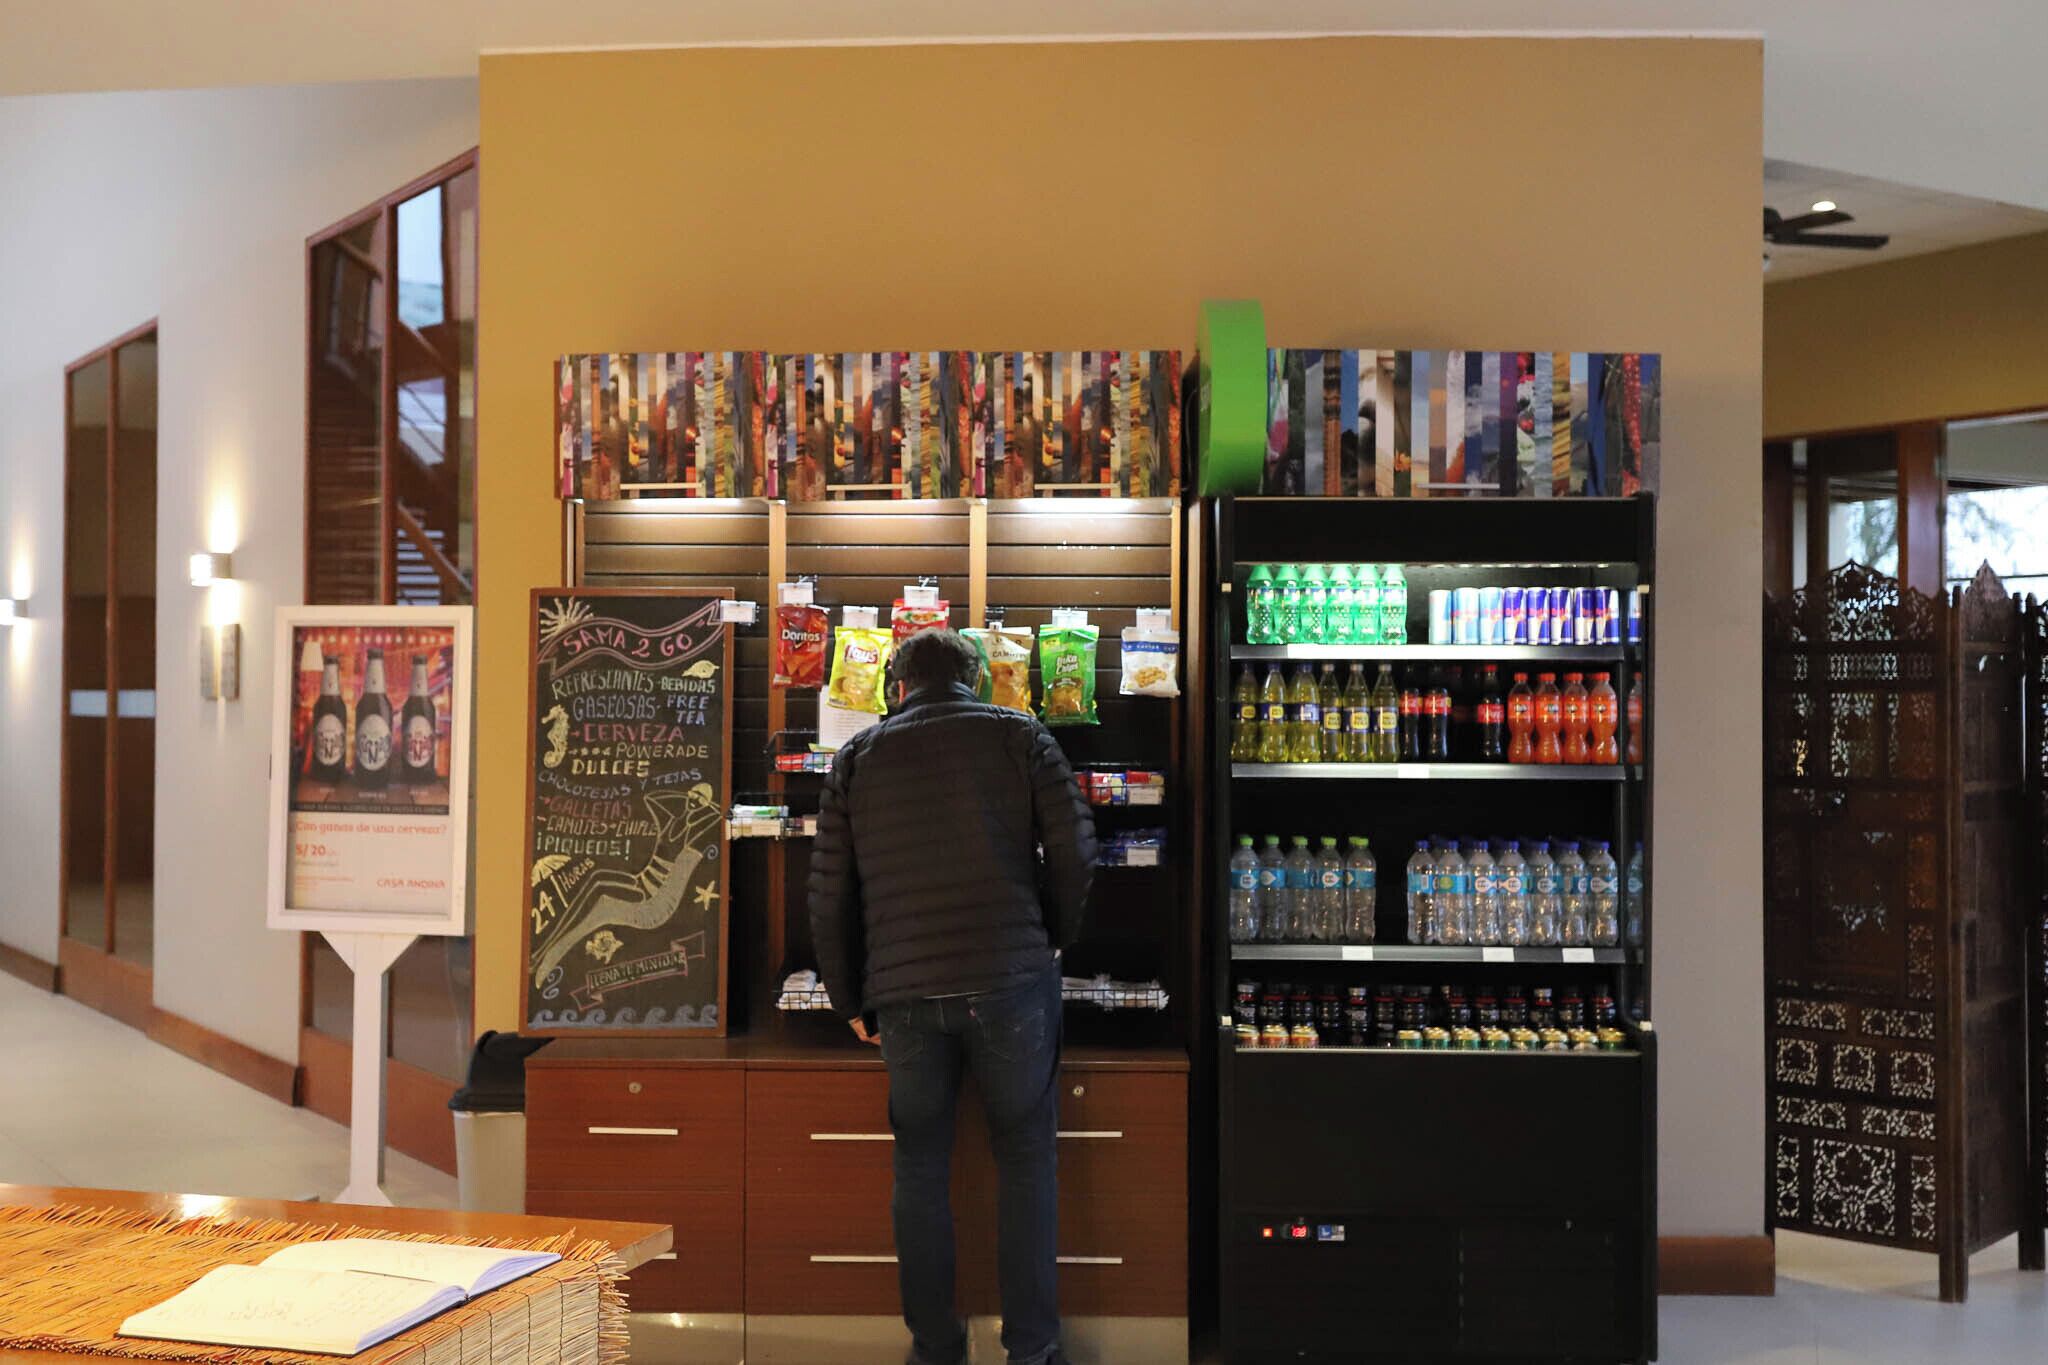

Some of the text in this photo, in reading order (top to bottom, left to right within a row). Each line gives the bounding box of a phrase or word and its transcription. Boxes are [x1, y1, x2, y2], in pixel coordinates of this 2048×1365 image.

[563, 627, 692, 657] SAMA 2 GO
[782, 629, 820, 642] Doritos
[552, 669, 654, 699] REFRESCANTES
[660, 676, 716, 694] BEBIDAS
[573, 695, 656, 721] GASEOSAS
[667, 695, 709, 710] FREE
[676, 710, 706, 726] TEA
[584, 723, 685, 743] CERVEZA
[616, 742, 709, 758] POWERADE
[571, 759, 651, 777] DULCES
[538, 768, 702, 799] CHOCOTEJAS Y TEJAS
[550, 798, 633, 819] GALLETAS
[356, 821, 370, 832] de
[373, 823, 395, 833] una
[376, 878, 446, 889] CASA ANDINA
[531, 891, 556, 934] 24
